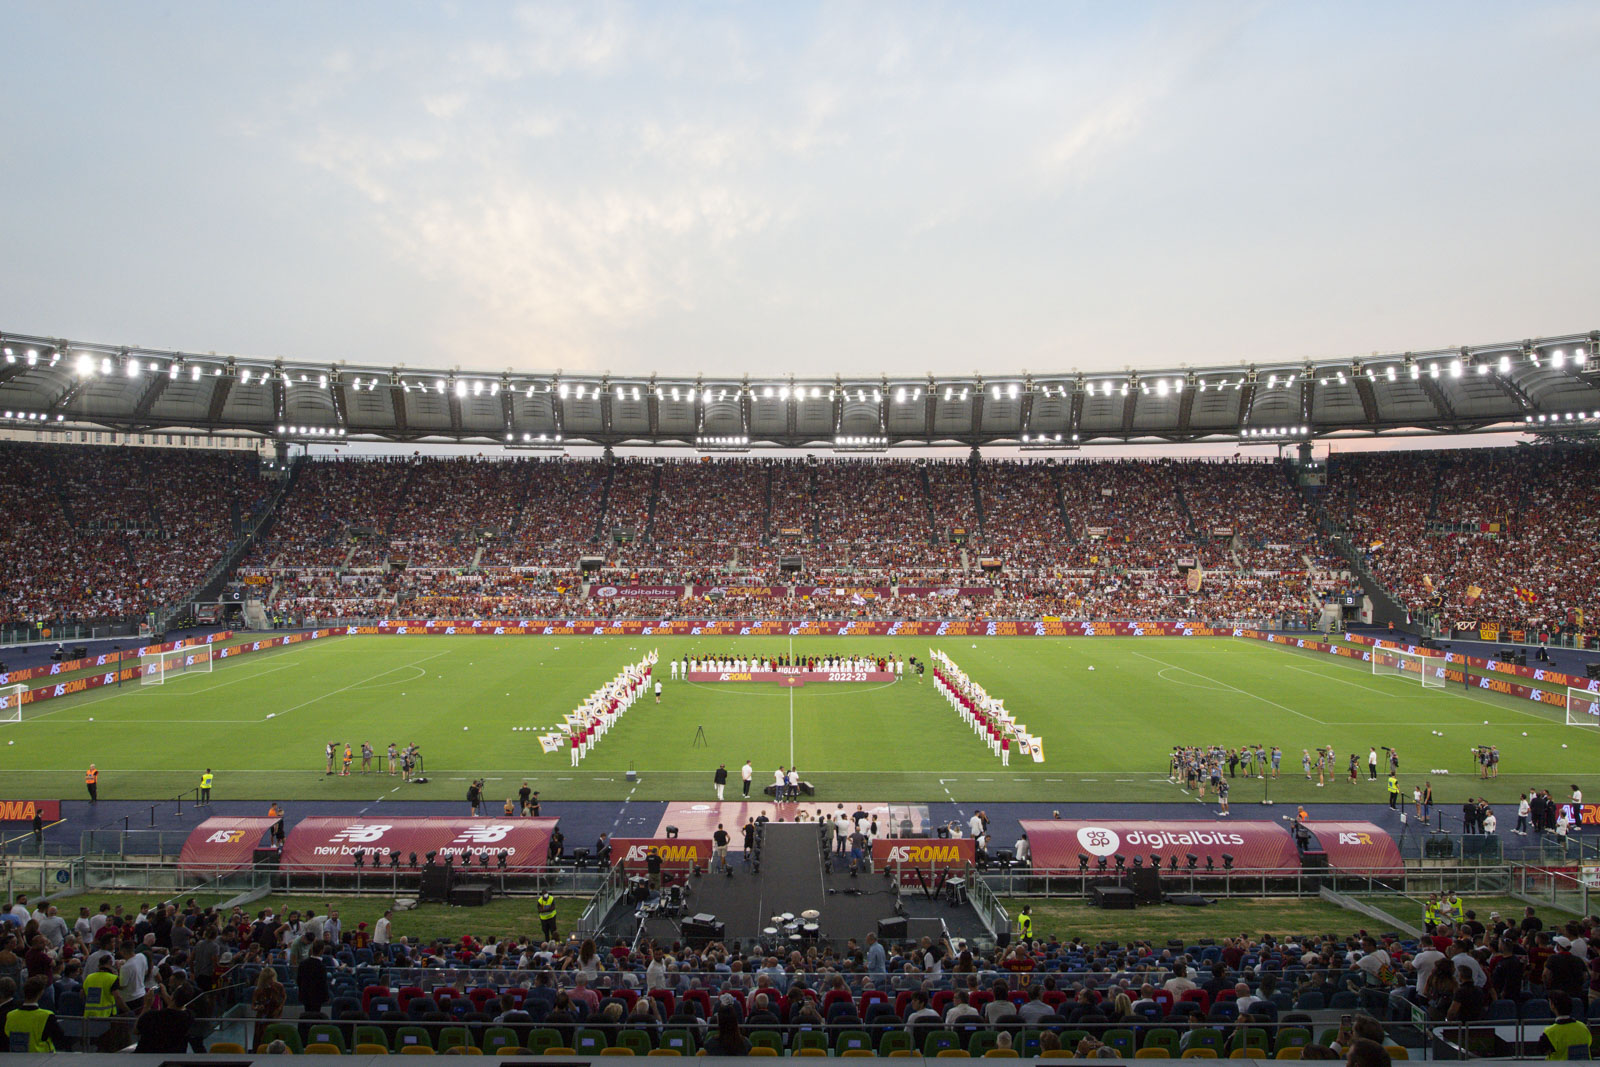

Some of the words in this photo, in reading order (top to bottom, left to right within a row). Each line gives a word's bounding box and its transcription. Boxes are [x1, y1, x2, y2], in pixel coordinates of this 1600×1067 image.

[620, 588, 676, 596] digitalbits
[50, 660, 80, 675] ASROMA
[1486, 660, 1516, 675] ASROMA
[720, 672, 752, 680] ASROMA
[828, 672, 867, 681] 2022-23
[1534, 668, 1567, 686] ASROMA
[54, 678, 87, 696] ASROMA
[1480, 677, 1512, 694] ASROMA
[1530, 688, 1567, 708] ASROMA
[206, 830, 246, 843] ASR
[1126, 831, 1244, 848] digitalbits
[1339, 833, 1373, 844] ASR
[314, 846, 339, 855] new
[340, 845, 391, 856] balance
[440, 846, 466, 856] new
[887, 846, 960, 862] ASROMA
